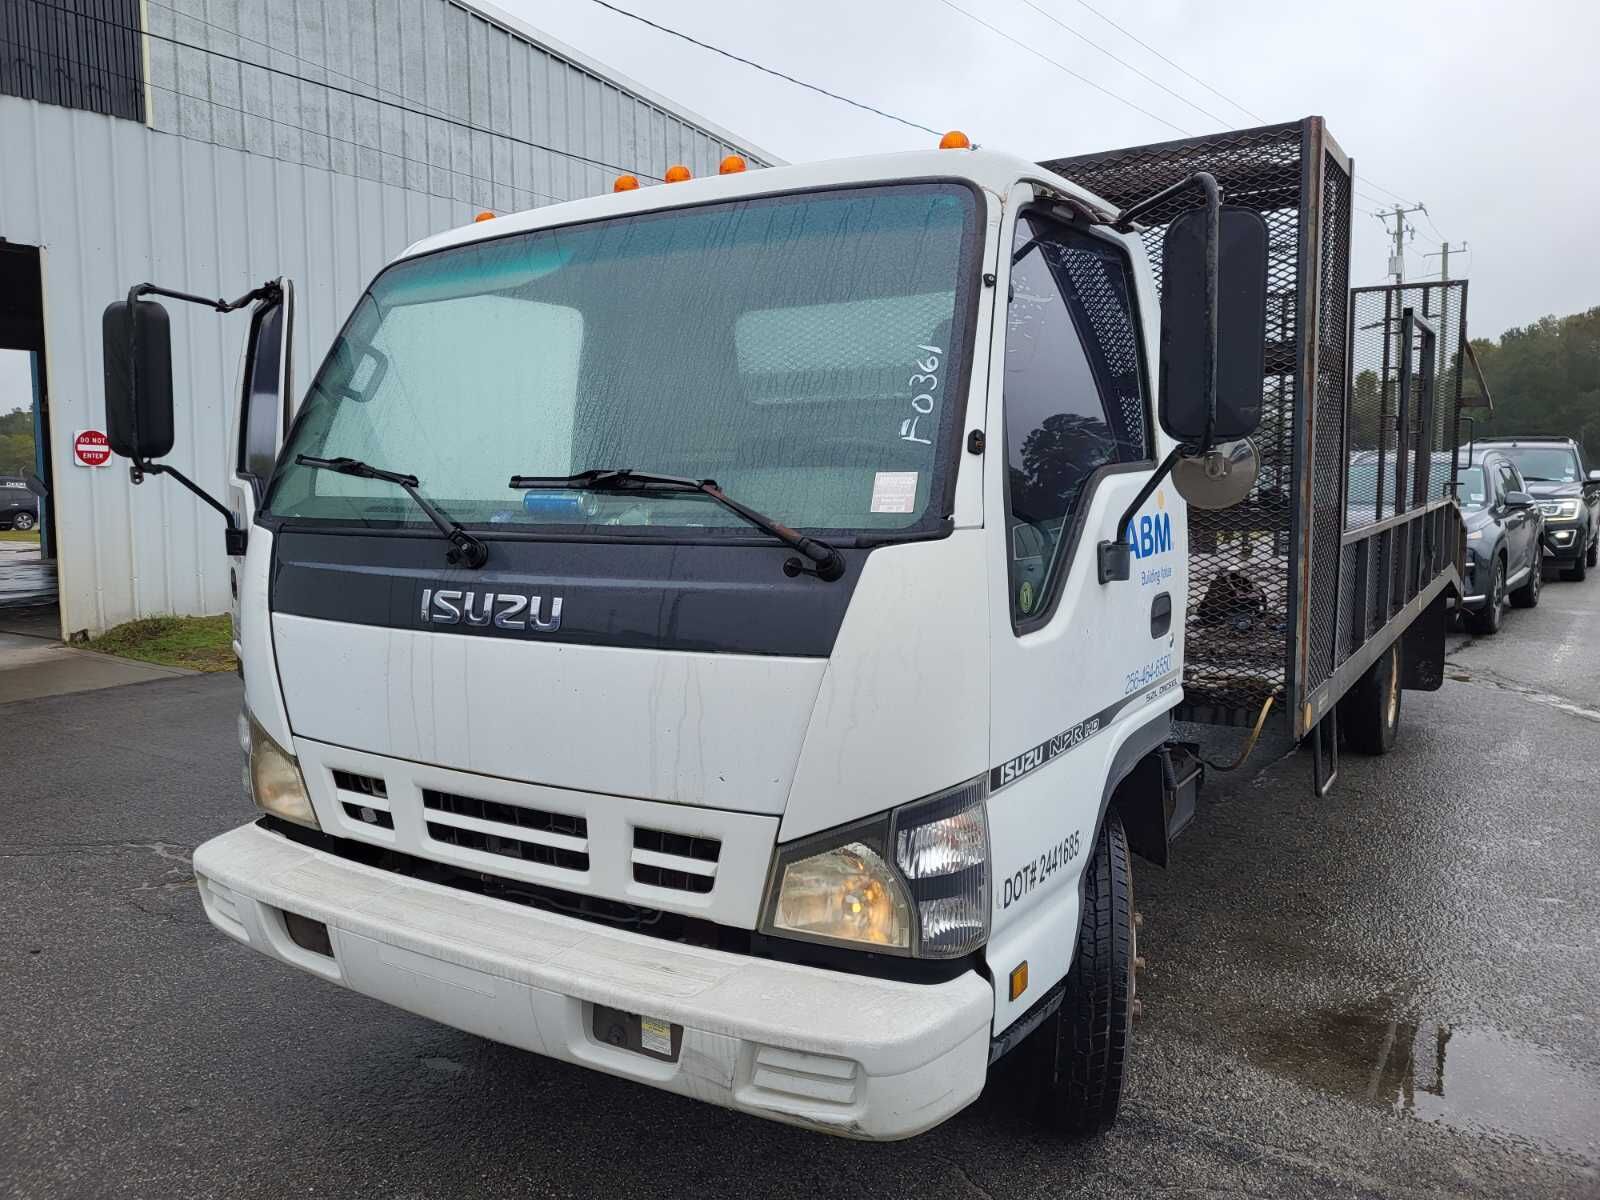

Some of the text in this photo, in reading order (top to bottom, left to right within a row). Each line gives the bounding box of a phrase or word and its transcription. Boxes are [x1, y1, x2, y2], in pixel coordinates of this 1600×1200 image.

[1126, 512, 1171, 559] ABM
[1141, 568, 1160, 586] Building
[420, 588, 563, 633] ISUZU
[1000, 719, 1100, 785] ISUZU NPR HD
[1003, 830, 1080, 909] DOT# 2441685
